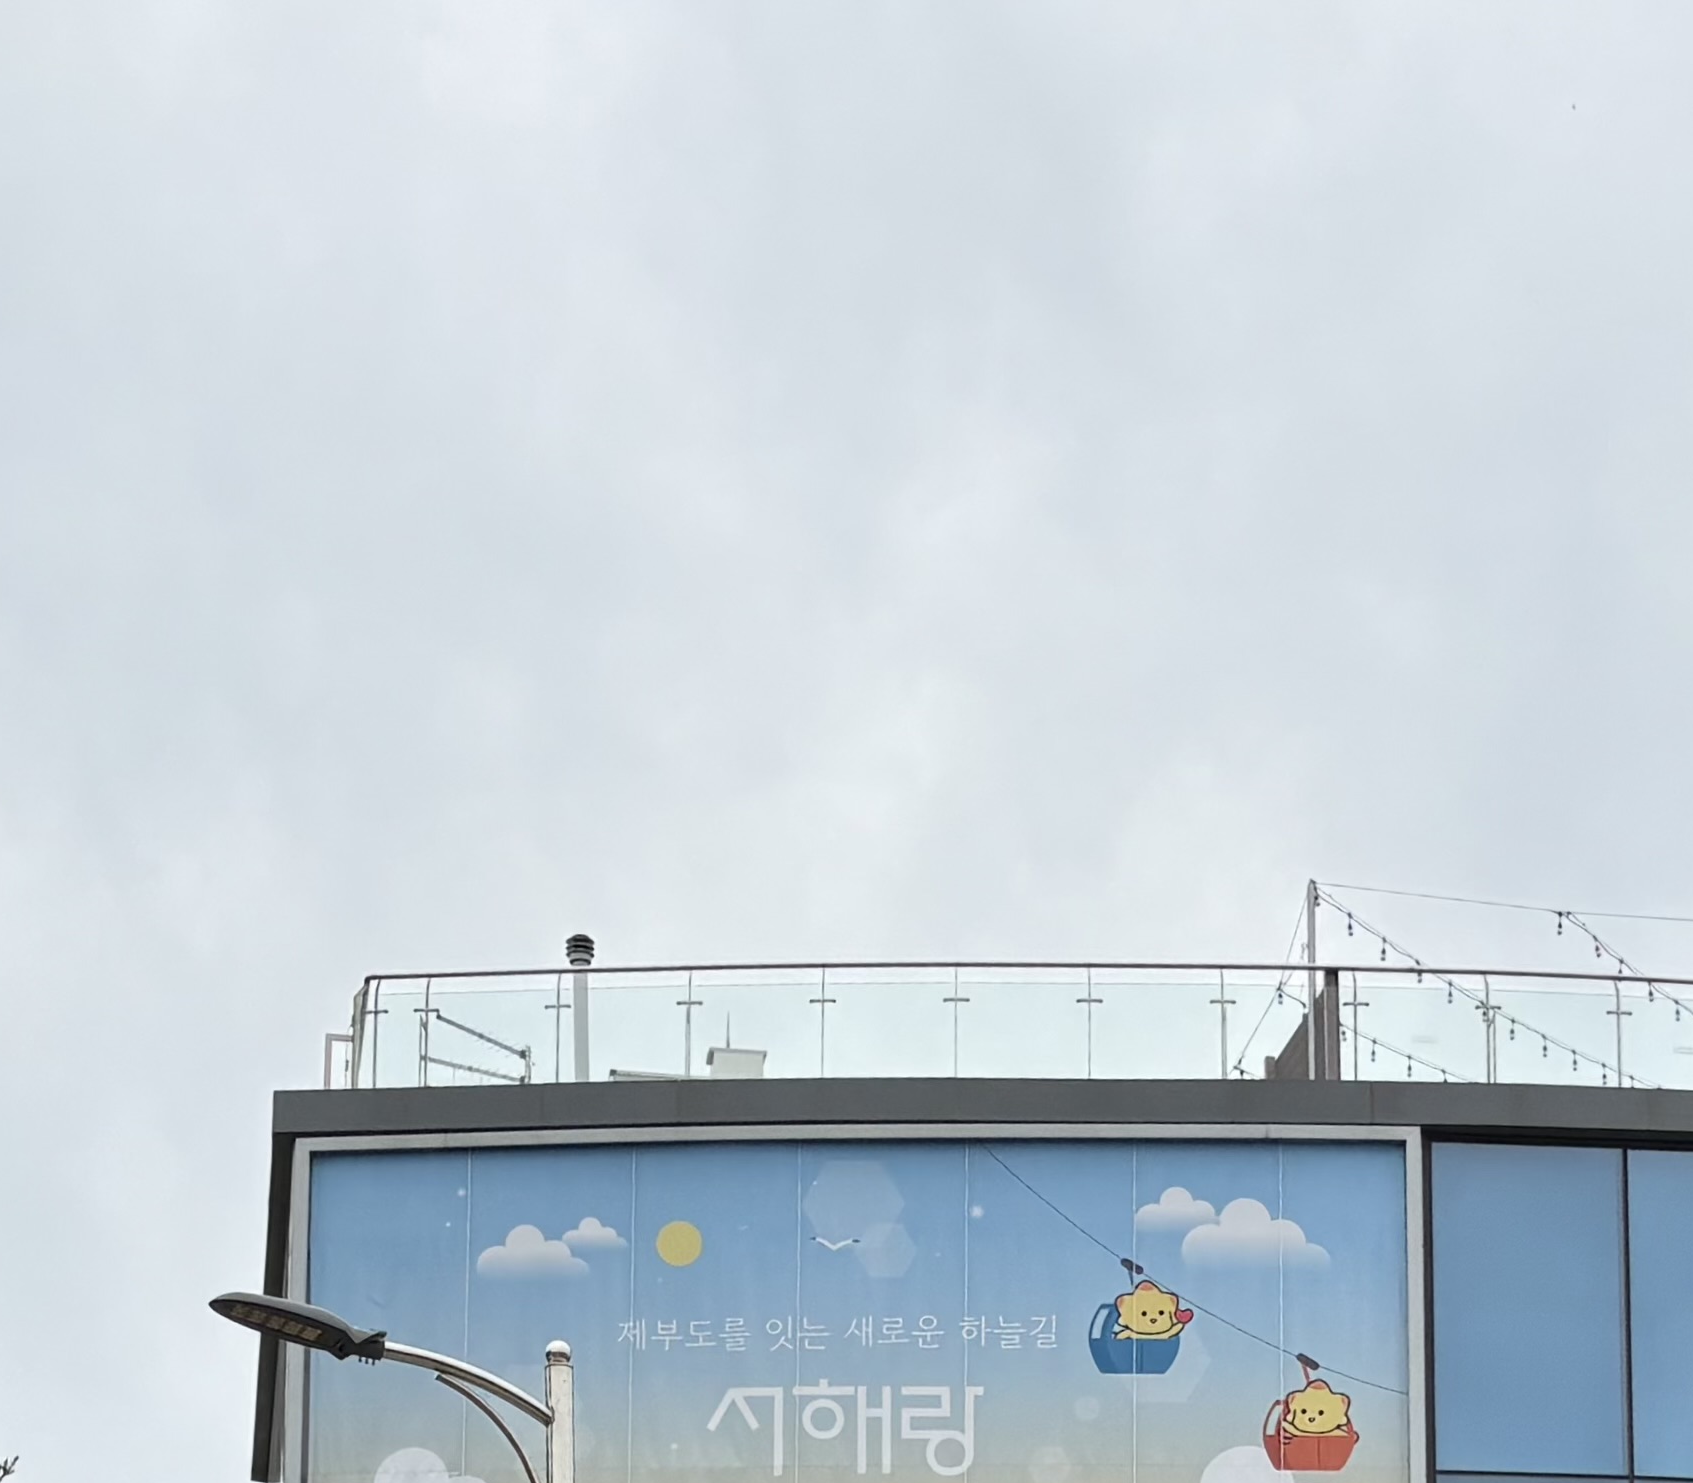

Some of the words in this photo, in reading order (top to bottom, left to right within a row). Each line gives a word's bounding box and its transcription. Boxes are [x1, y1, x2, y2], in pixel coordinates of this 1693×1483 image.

[617, 1317, 752, 1351] 제부도를
[765, 1315, 832, 1351] 잇는
[843, 1314, 946, 1349] 새로운
[959, 1314, 1058, 1349] 하늘길
[706, 1378, 985, 1477] 서해랑
